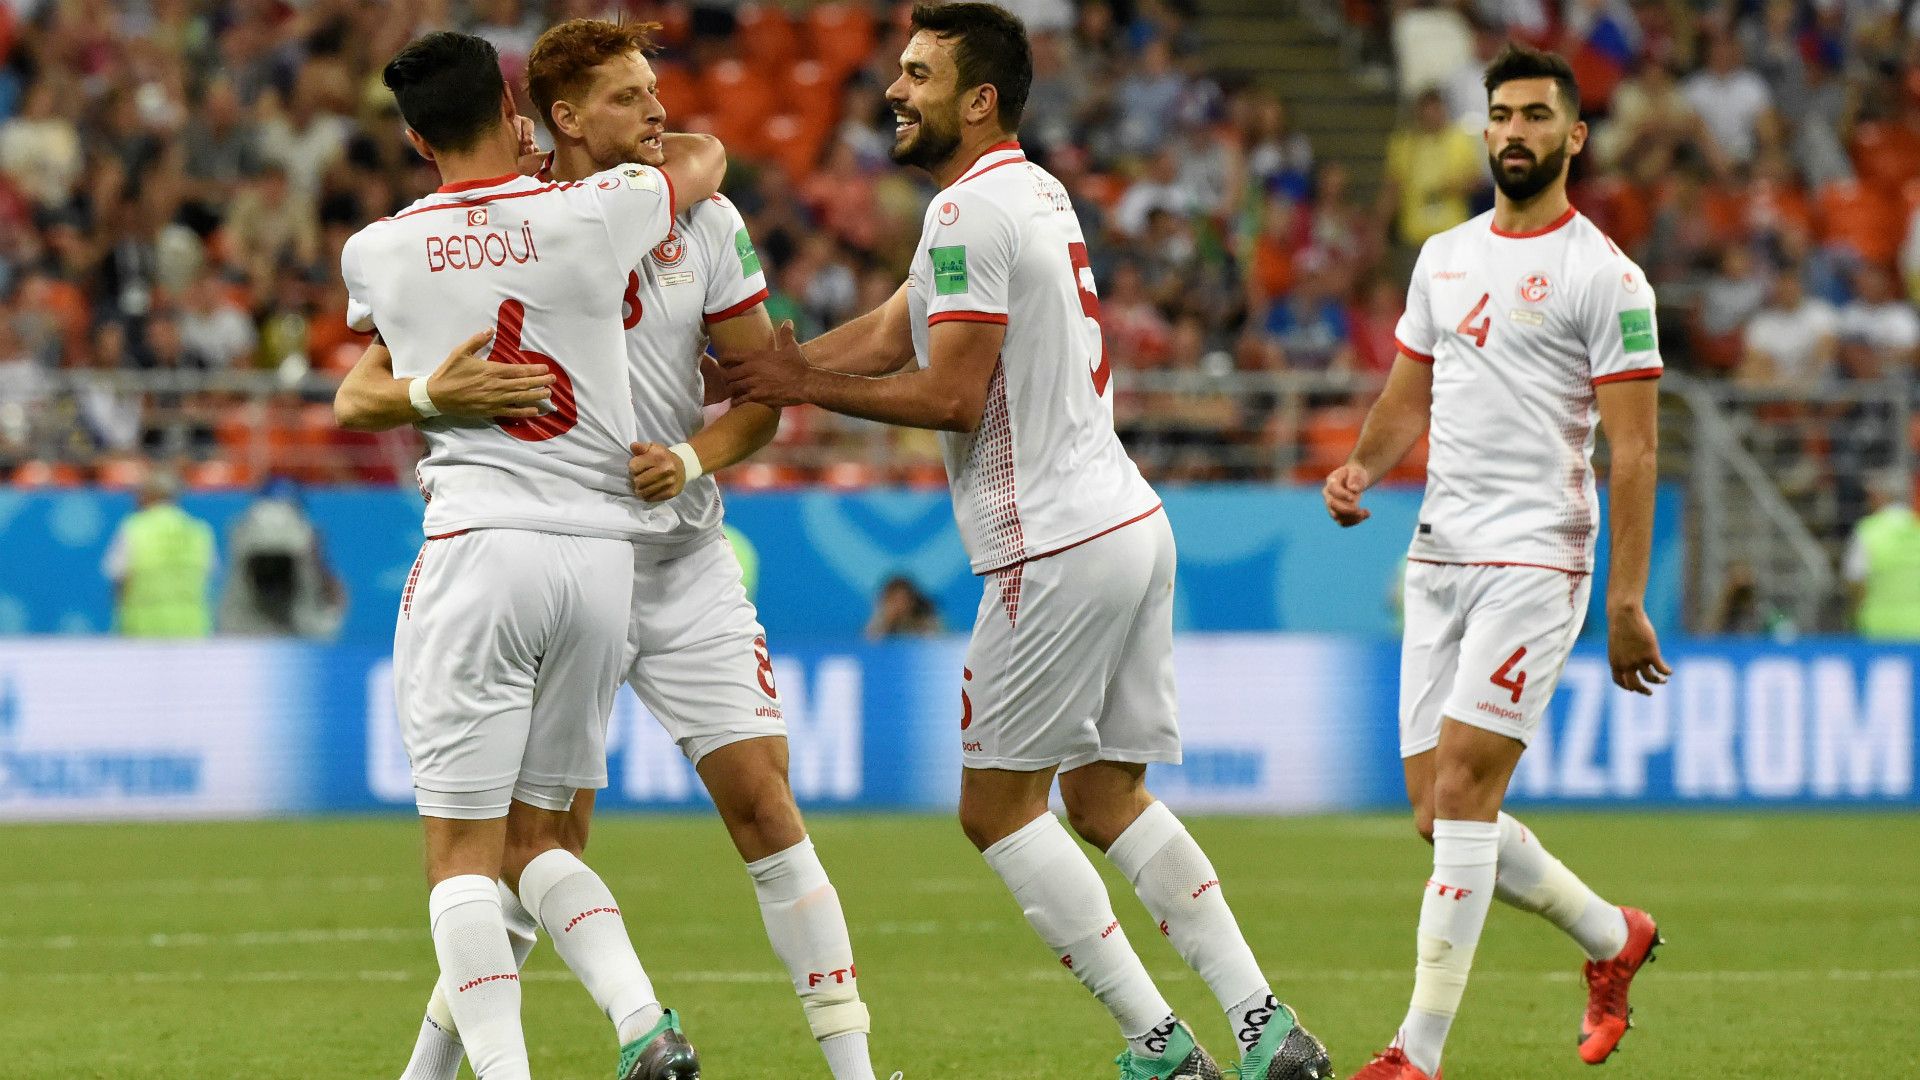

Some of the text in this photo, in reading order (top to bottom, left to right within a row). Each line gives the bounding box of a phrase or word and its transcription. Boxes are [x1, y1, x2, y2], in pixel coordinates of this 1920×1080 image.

[1456, 293, 1491, 348] 4
[487, 298, 578, 442] 6
[753, 637, 777, 699] 8
[1489, 646, 1527, 704] 4
[1477, 701, 1522, 721] uhlsport
